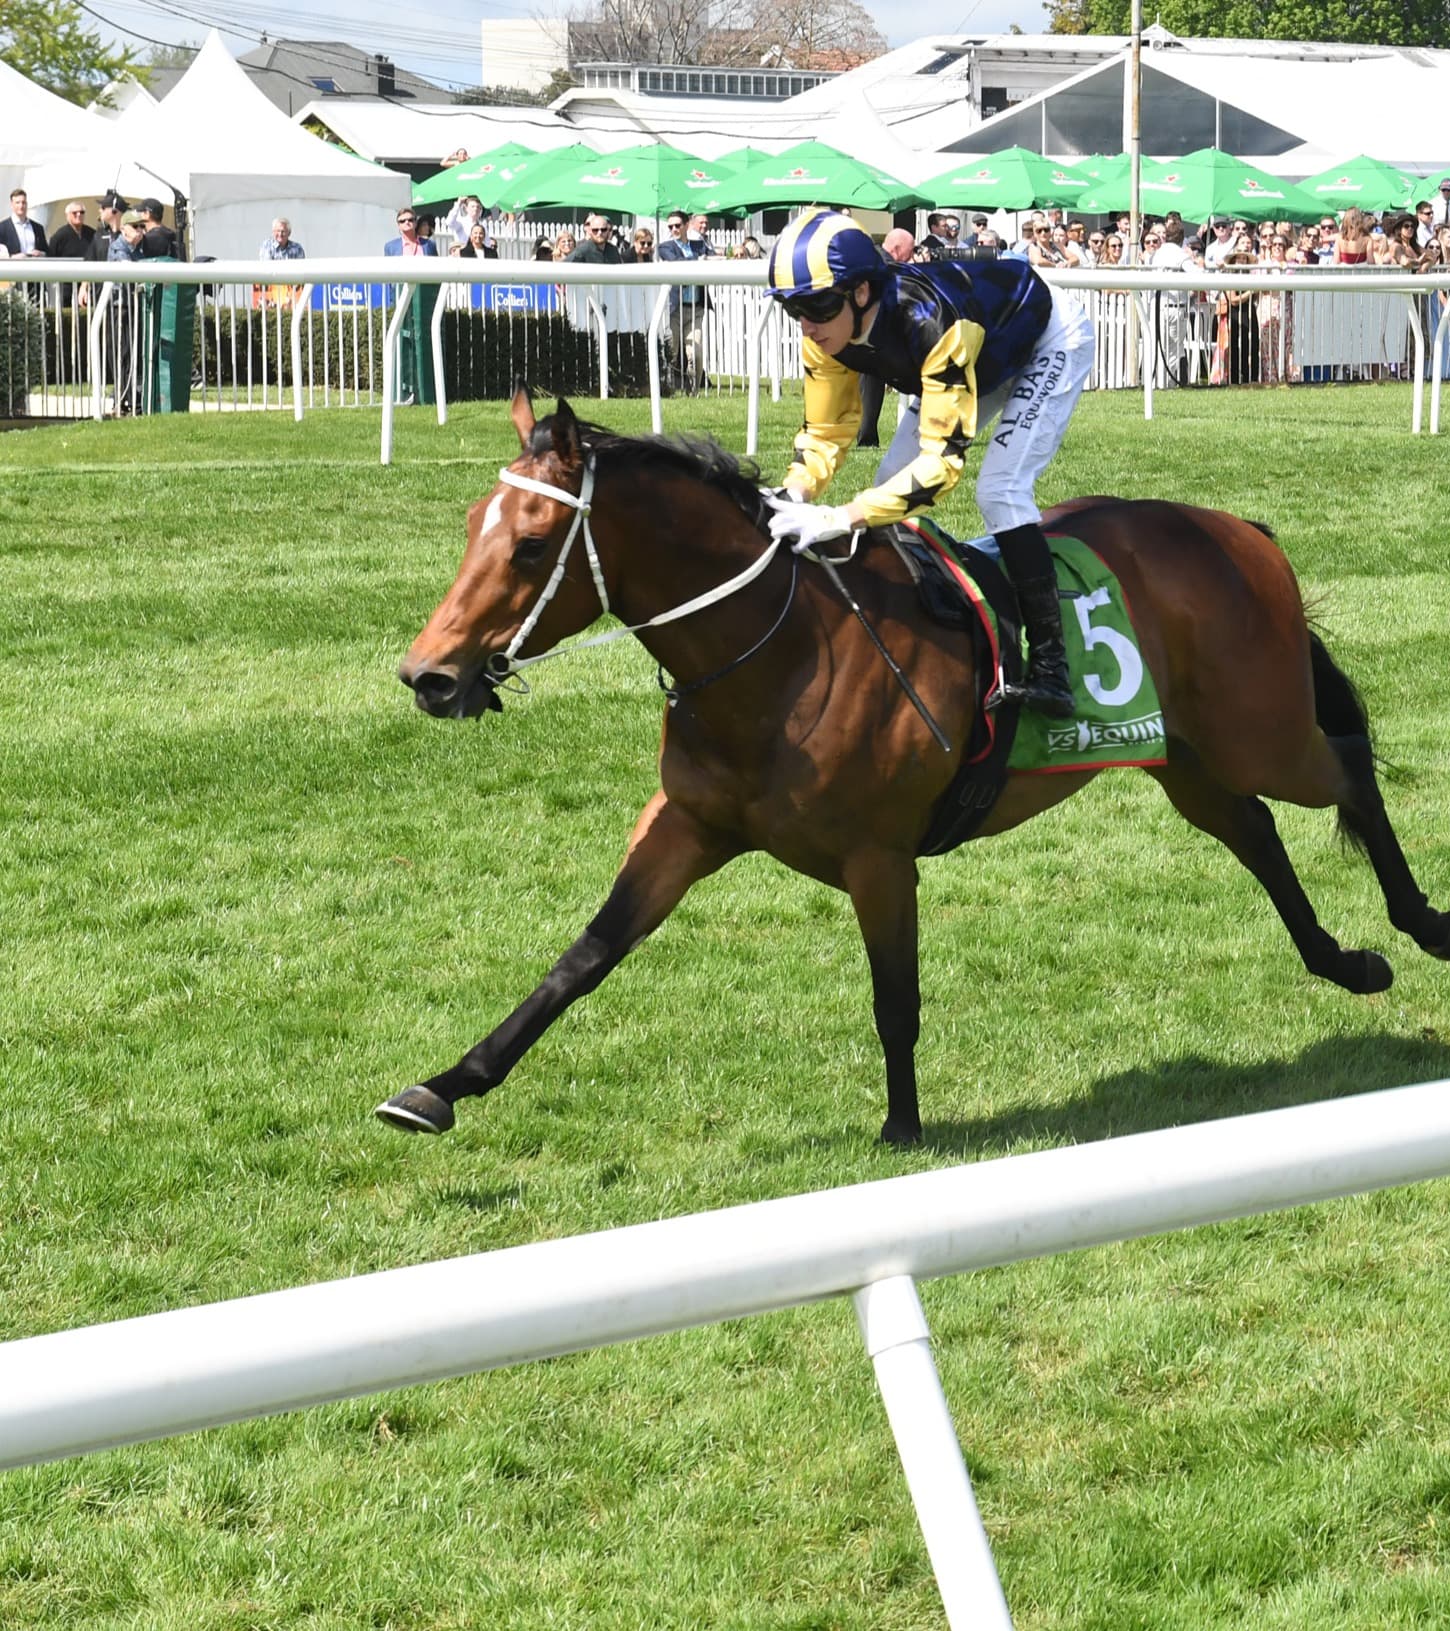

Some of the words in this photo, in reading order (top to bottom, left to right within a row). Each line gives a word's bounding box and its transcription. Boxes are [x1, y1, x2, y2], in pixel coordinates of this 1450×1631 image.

[993, 411, 1021, 449] AL
[1012, 349, 1051, 401] BAS
[1073, 586, 1144, 707] 5
